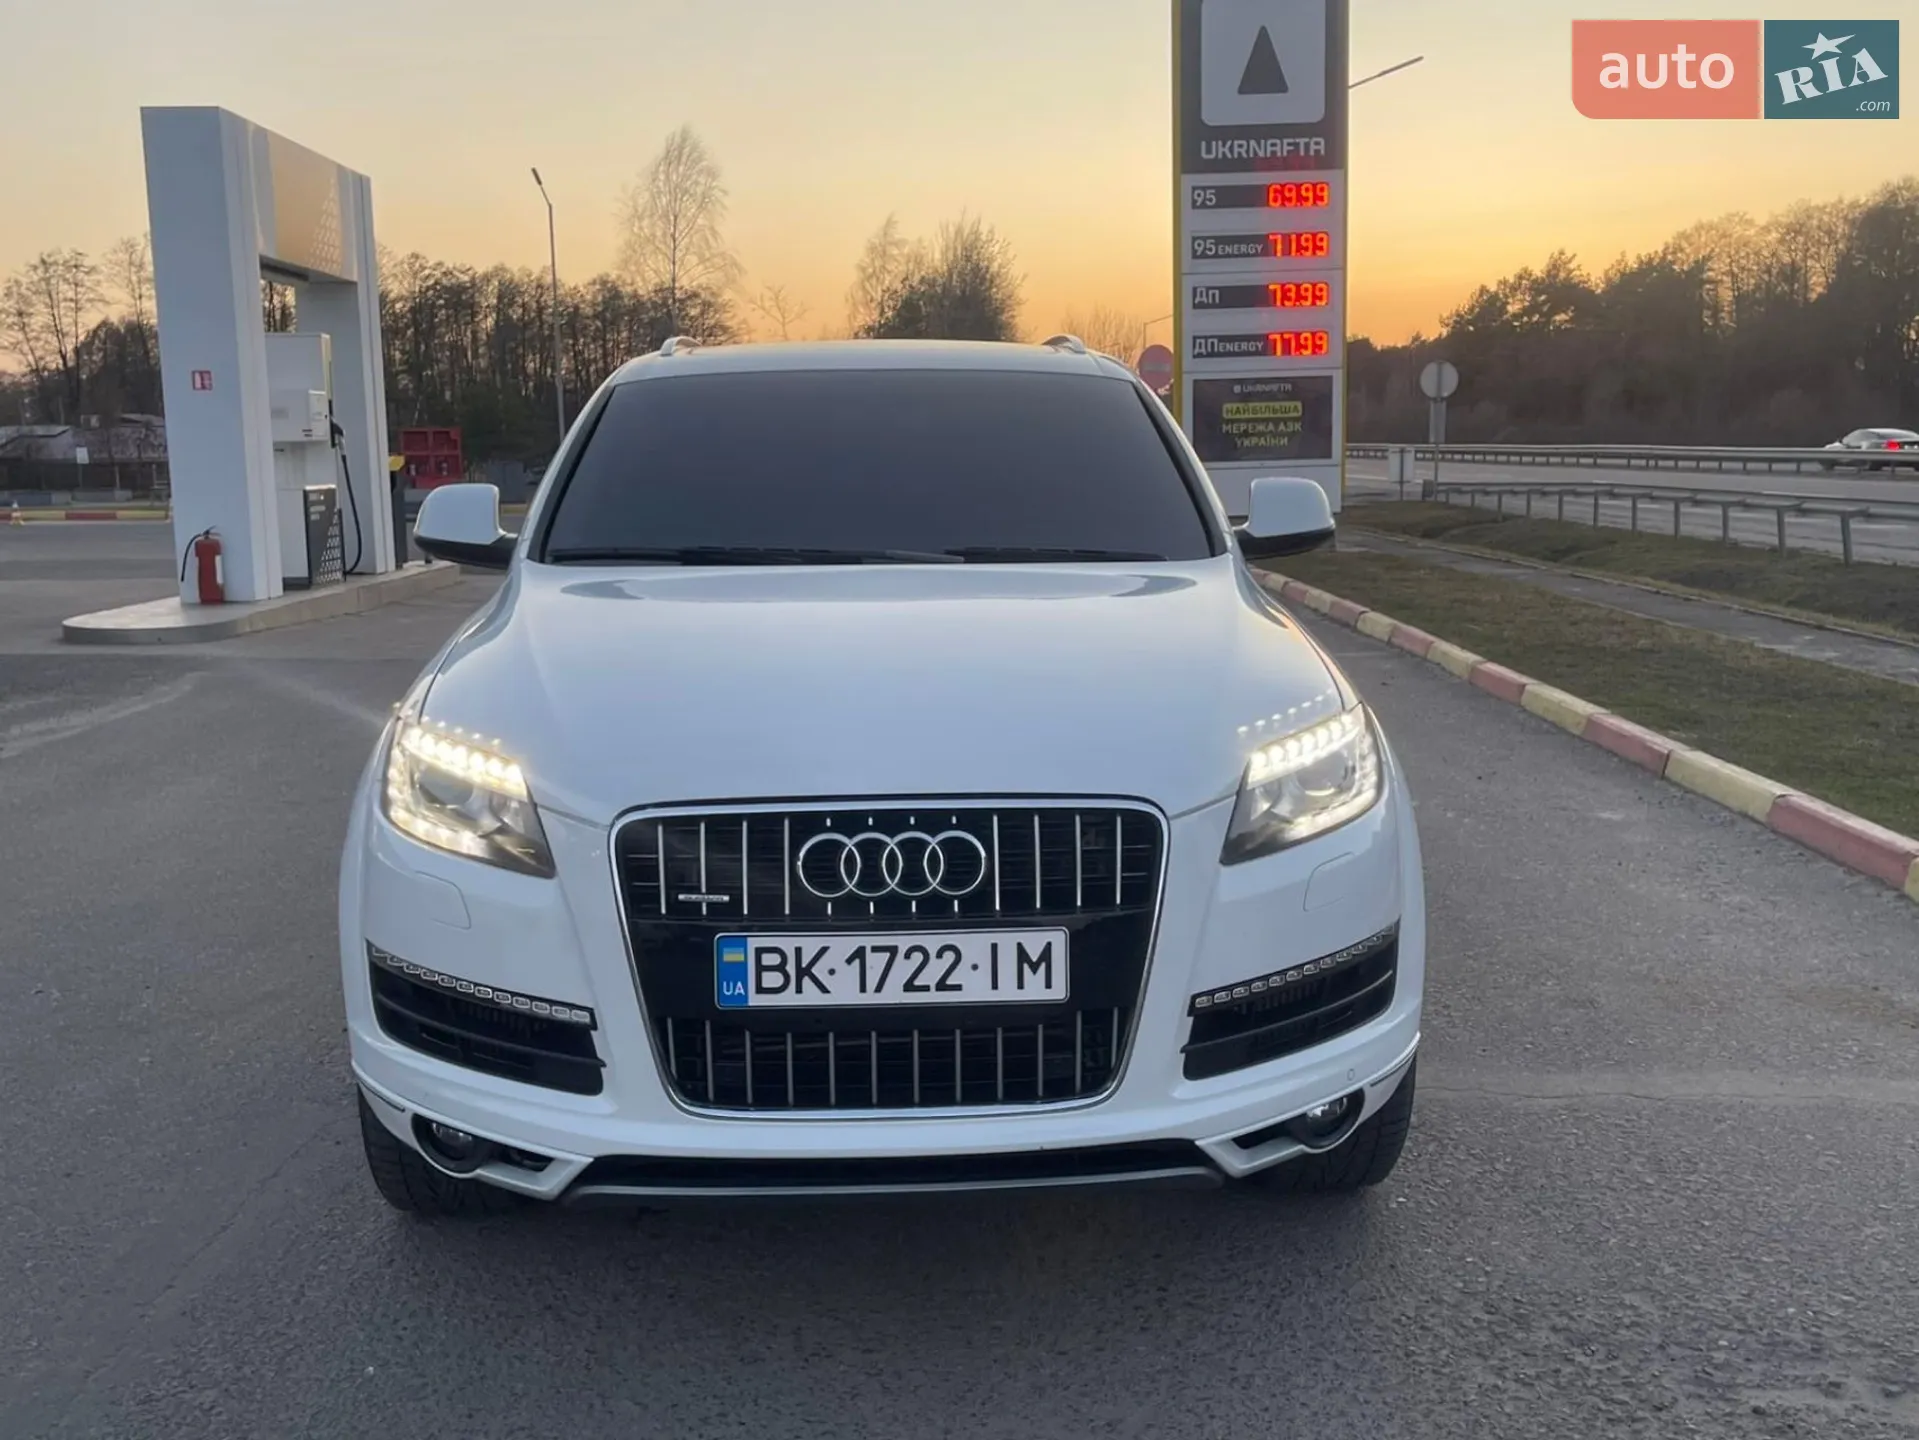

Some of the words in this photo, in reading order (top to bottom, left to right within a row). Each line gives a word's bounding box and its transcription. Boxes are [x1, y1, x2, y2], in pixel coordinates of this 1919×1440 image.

[1200, 137, 1325, 159] UKRNAFTA
[1193, 189, 1216, 206] 95
[1268, 183, 1329, 207] 69.99
[1194, 239, 1216, 255] 95
[1218, 243, 1263, 255] ENERGY
[1268, 232, 1329, 257] 71.99
[1194, 287, 1220, 304] ДП
[1268, 282, 1329, 307] 73.99
[1268, 331, 1329, 356] 77.99
[1226, 403, 1300, 416] НАЙБІЛЬША
[1222, 421, 1275, 434] МЕРЕЖА
[1277, 420, 1303, 432] АЗК
[1235, 434, 1288, 448] УКРАЇНИ
[722, 980, 745, 996] UA
